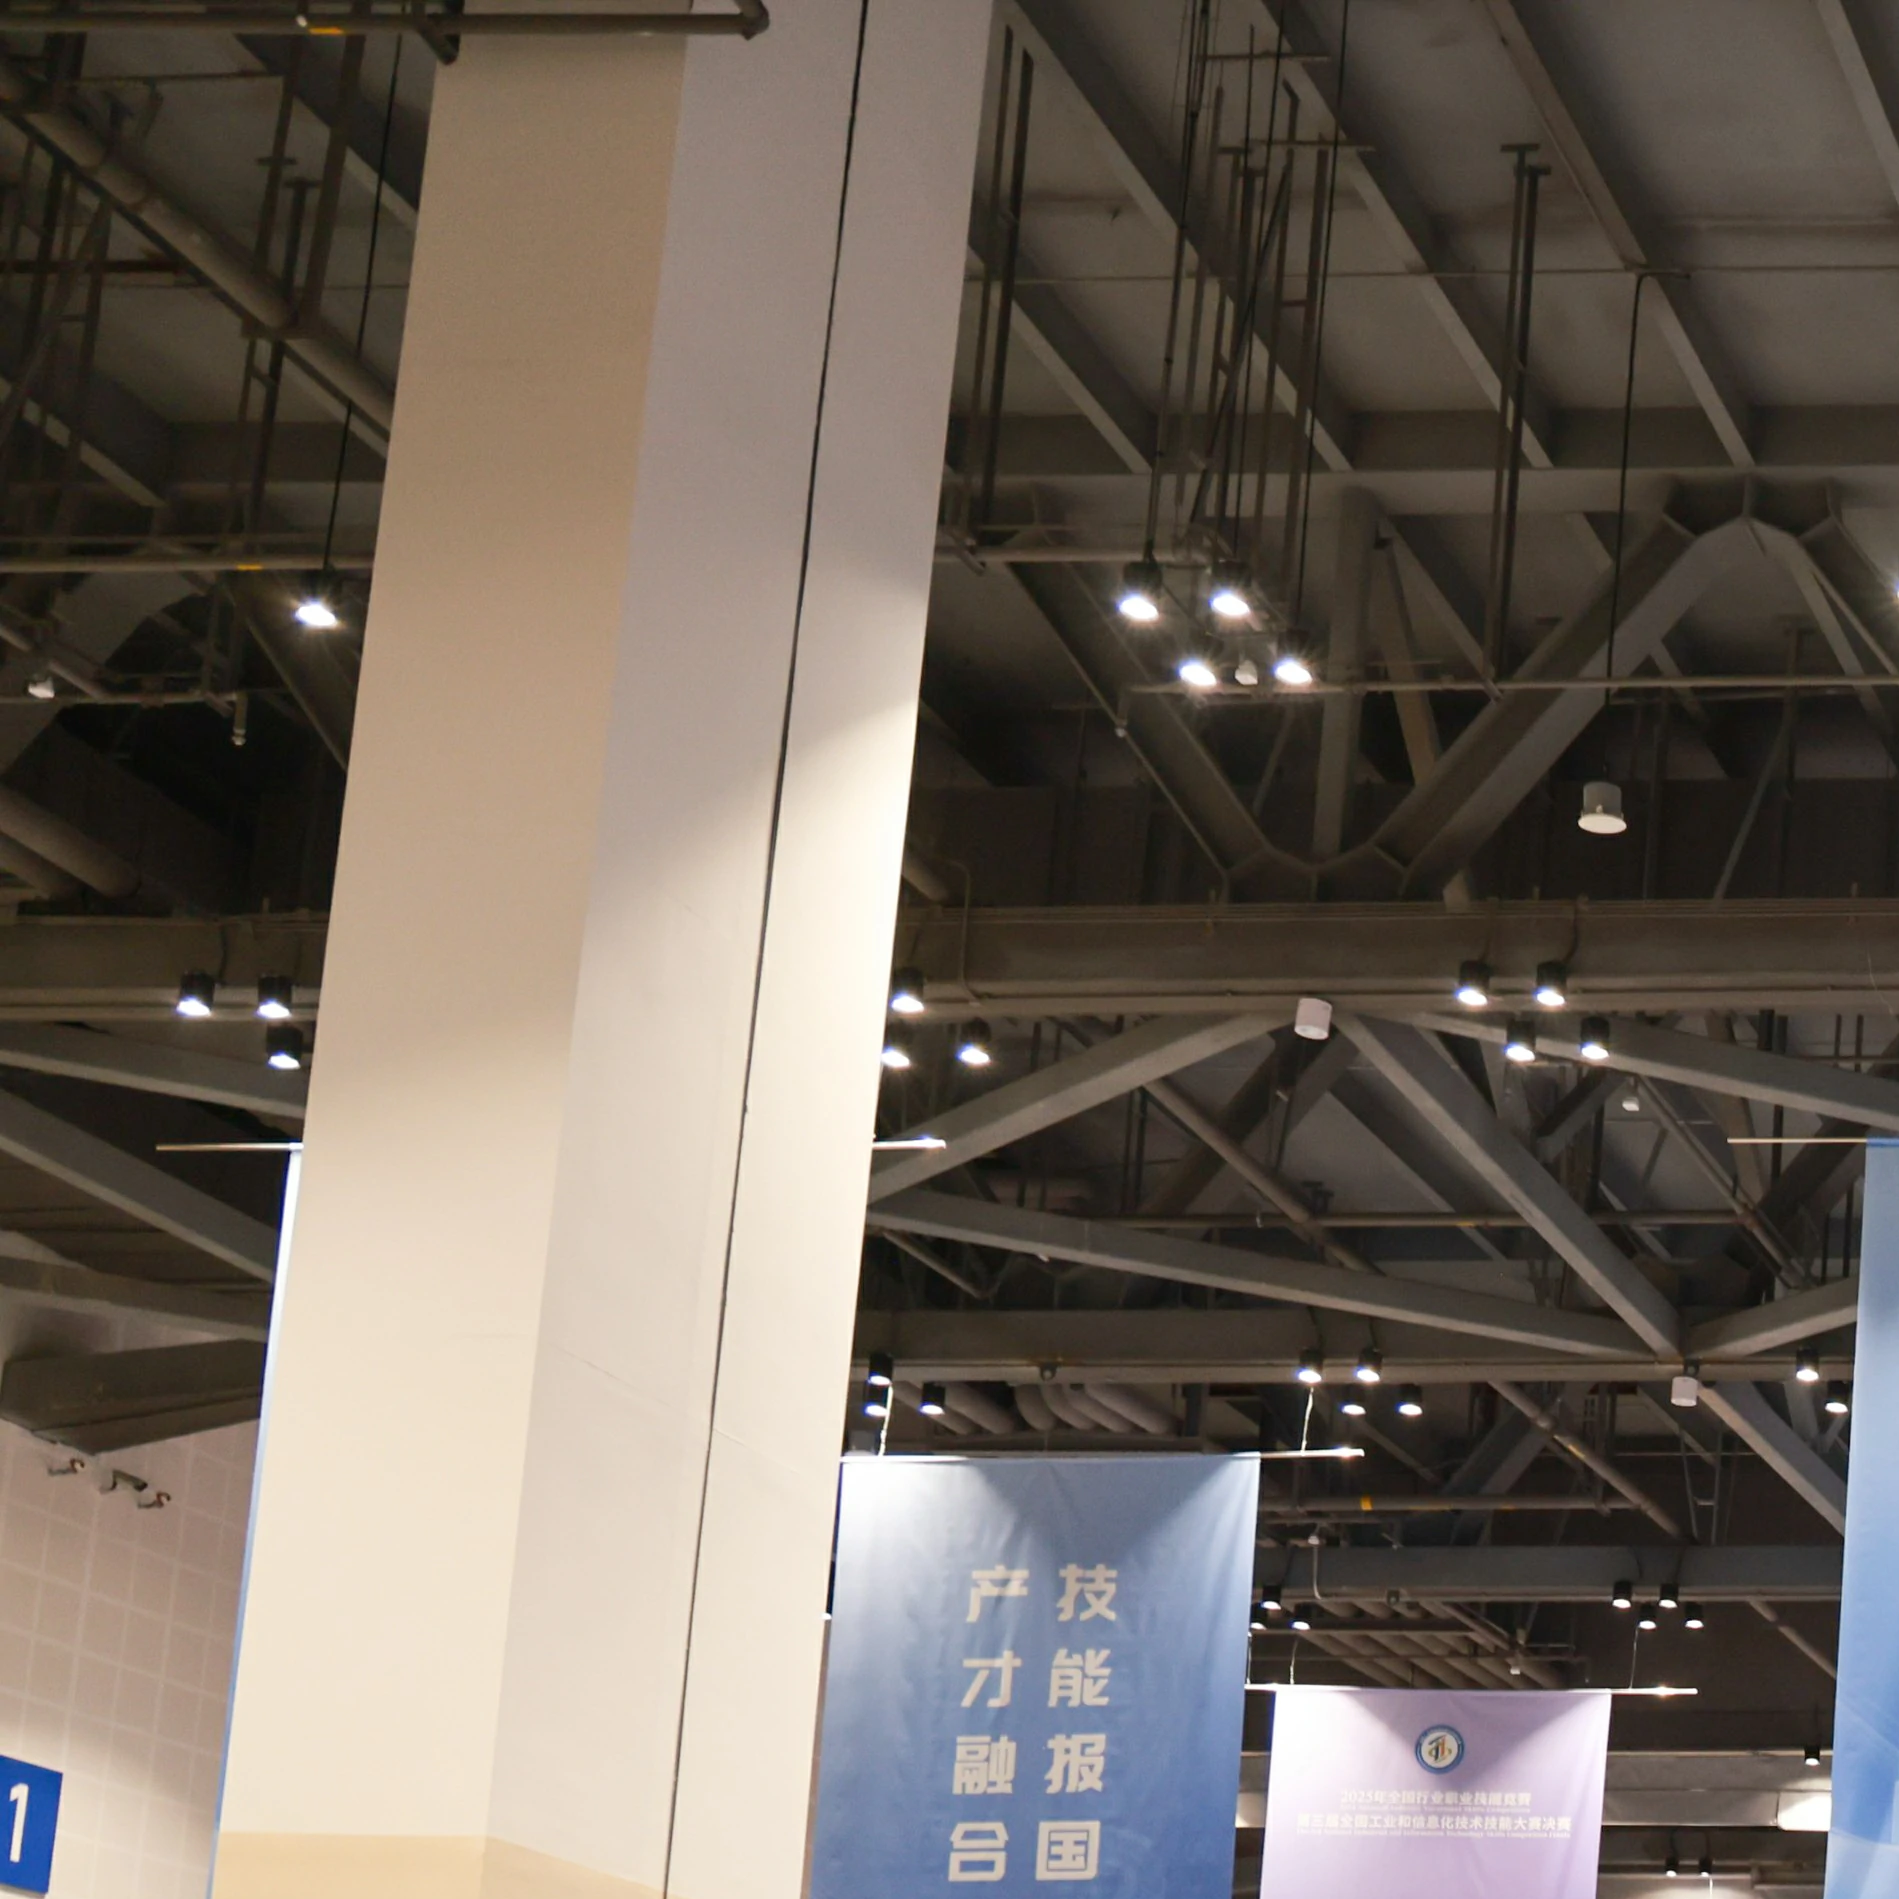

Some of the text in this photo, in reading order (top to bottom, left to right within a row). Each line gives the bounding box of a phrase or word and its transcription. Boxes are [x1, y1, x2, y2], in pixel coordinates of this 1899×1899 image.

[9, 1782, 29, 1863] 1
[947, 1565, 1029, 1882] 产才融合
[1036, 1563, 1118, 1881] 技能报国
